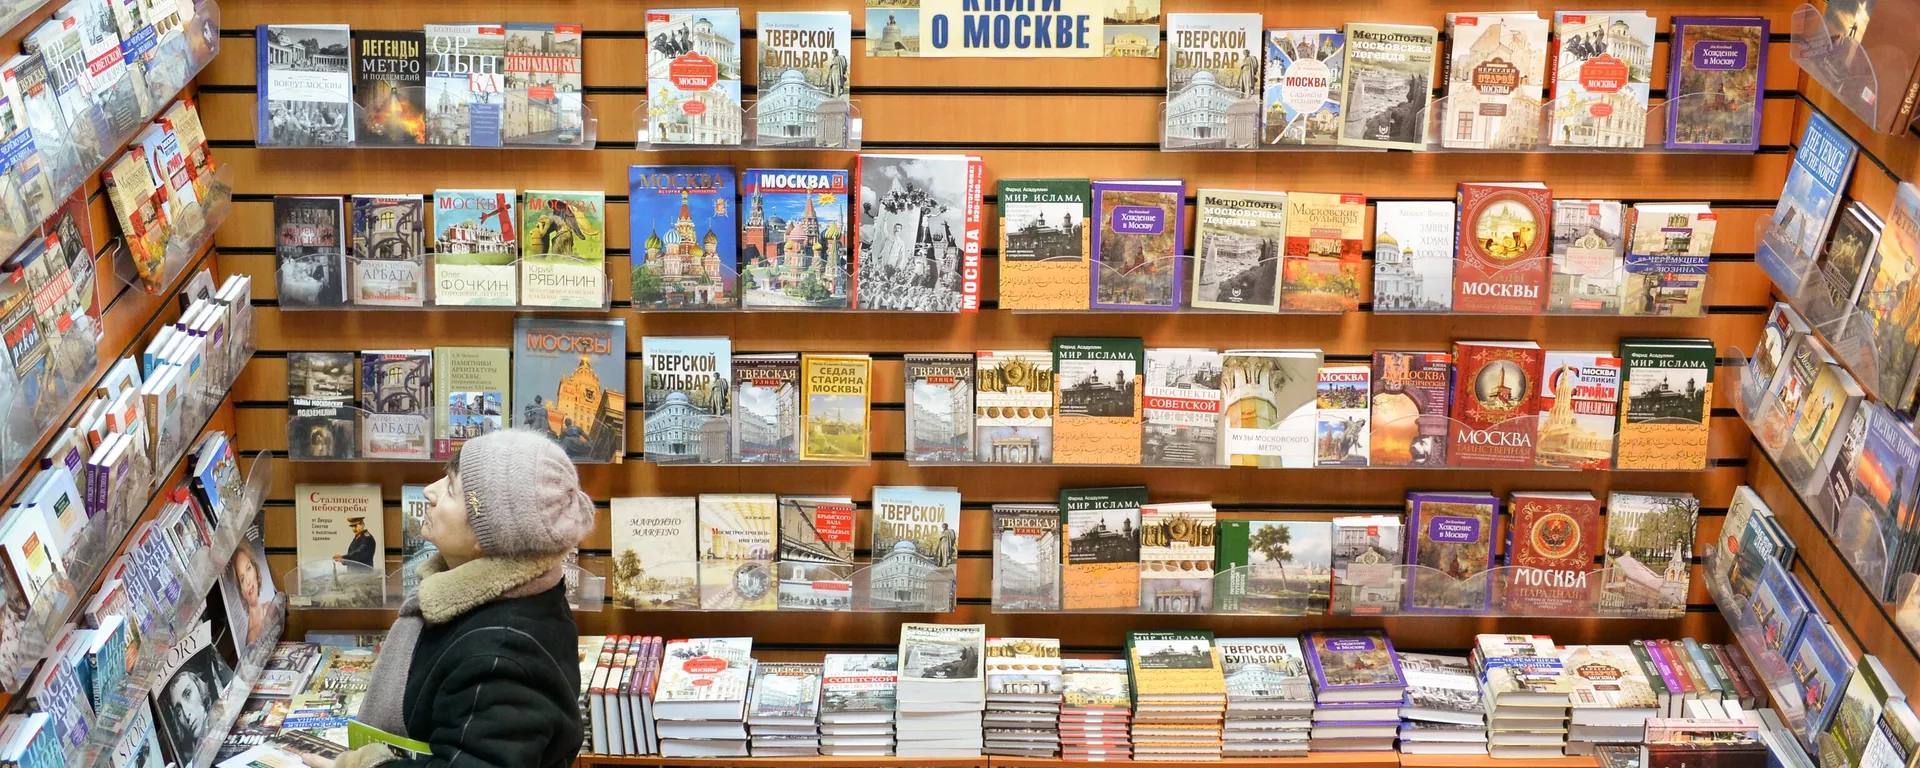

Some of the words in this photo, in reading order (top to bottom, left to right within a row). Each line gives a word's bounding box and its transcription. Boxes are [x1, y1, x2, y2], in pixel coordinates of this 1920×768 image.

[932, 15, 948, 48] О
[963, 15, 1090, 48] МОСКВЕ
[765, 27, 835, 50] ТВЕРСКОЙ
[1176, 28, 1247, 49] ТВЕРСКОЙ
[362, 39, 419, 59] ЛЕГЕНДЫ
[1351, 41, 1432, 54] московская
[1702, 48, 1739, 59] Хождение
[90, 46, 123, 75] СОВЕТСКОЙ
[765, 50, 829, 70] БУЛЬВАР
[1176, 51, 1240, 70] БУЛЬВАР
[1350, 50, 1406, 63] легенда
[1709, 57, 1736, 68] Москву
[362, 58, 420, 74] МЕТРО
[507, 57, 577, 73] ЯКИМАНКА
[362, 73, 369, 81] И
[370, 72, 420, 82] ПОДЗЕМЕЛИЙ
[678, 77, 708, 87] МОСКВЫ
[1286, 76, 1328, 88] МОСКВА
[1477, 74, 1516, 86] СТАРОЙ
[273, 80, 304, 88] ВОКРУГ
[305, 80, 343, 90] МОСКВЫ
[1480, 85, 1510, 94] МОСКВЫ
[1588, 80, 1618, 89] МОСКВЫ
[1905, 82, 1920, 105] Pete
[1901, 102, 1911, 116] St
[1804, 127, 1821, 152] THE
[1817, 139, 1846, 173] VENICE
[1799, 147, 1809, 162] OF
[1806, 153, 1819, 173] THE
[1816, 164, 1838, 189] NORTH
[639, 172, 725, 191] МОСКВА
[761, 173, 831, 190] МОСКВА
[967, 164, 975, 215] ФОТОГРАФИЯХ
[1005, 193, 1031, 203] МИР
[1033, 193, 1082, 203] ИСЛАМА
[528, 197, 597, 213] МОСКВА
[1292, 203, 1360, 217] Московские
[1120, 212, 1156, 223] Хождение
[1203, 207, 1282, 219] московская
[1203, 215, 1257, 228] легенда
[1309, 214, 1360, 226] бульвары
[1891, 204, 1920, 245] PETER
[1128, 222, 1154, 232] Москву
[1420, 222, 1450, 233] ТАЙНЫ
[1420, 236, 1450, 246] ХРАМА
[1416, 249, 1449, 259] ХРИСТА
[362, 268, 415, 281] АРБАТА
[440, 270, 460, 280] Олег
[528, 265, 554, 275] Юрий
[962, 229, 980, 310] МОСКВА
[1655, 265, 1696, 274] ЗЮЗИНА
[440, 279, 509, 292] ФОЧКИН
[528, 274, 596, 288] РЯБИНИН
[1462, 281, 1539, 299] МОСКВЫ
[527, 334, 612, 354] МОСКВЫ
[1059, 351, 1085, 360] МИР
[1088, 351, 1135, 360] ИСЛАМА
[650, 352, 717, 372] ТВЕРСКОЙ
[1381, 354, 1446, 382] МОСКВА
[1630, 359, 1657, 368] МИР
[1660, 359, 1707, 368] ИСЛАМА
[736, 367, 797, 380] ТВЕРСКАЯ
[819, 367, 856, 377] СЕДАЯ
[911, 366, 971, 378] ТВЕРСКАЯ
[1319, 373, 1365, 382] МОСКВА
[1582, 367, 1615, 377] МОСКВА
[650, 373, 711, 391] БУЛЬВАР
[754, 379, 780, 387] УЛИЦА
[811, 376, 864, 385] СТАРИНА
[928, 376, 954, 384] УЛИЦА
[1581, 376, 1616, 385] ВЕЛИКИЕ
[812, 384, 862, 393] МОСКВЫ
[1151, 387, 1217, 399] ПРОСПЕКТЫ
[293, 399, 311, 408] ТАЙНЫ
[311, 399, 344, 409] МОСКОВСКИХ
[1149, 399, 1217, 411] СОВЕТСКОЙ
[1574, 401, 1614, 415] СОЦИАЛИЗМА
[297, 408, 338, 418] ПОДЗЕМЕЛИЙ
[1150, 411, 1217, 424] МОСКВЫ
[371, 423, 423, 435] АРБАТА
[1232, 434, 1254, 443] МУЗЫ
[1255, 434, 1309, 444] МОСКОВСКОГО
[1457, 429, 1531, 448] МОСКВА
[1873, 412, 1899, 448] БЕЛЫЕ
[1897, 438, 1918, 469] НОЧИ
[1258, 444, 1283, 452] МЕТРО
[1456, 444, 1530, 457] ТАИНСТВЕННАЯ
[309, 491, 369, 504] Сталинские
[311, 505, 367, 513] небоскребы
[1068, 501, 1090, 510] МИР
[1098, 500, 1140, 509] ИСЛАМА
[881, 503, 946, 523] ТВЕРСКОЙ
[629, 517, 682, 526] МАРФИНО
[998, 517, 1057, 529] ТВЕРСКАЯ
[1438, 522, 1472, 533] Хождение
[631, 528, 681, 537] MARFINO
[880, 521, 939, 540] БУЛЬВАР
[1445, 531, 1469, 541] Москву
[1514, 569, 1587, 589] МОСКВА
[1519, 588, 1579, 599] ПАРАДНАЯ
[1222, 644, 1287, 655] ТВЕРСКОЙ
[1225, 655, 1283, 664] БУЛЬВАР
[762, 666, 820, 674] ТВЕРСКАЯ
[324, 678, 368, 691] Москв
[118, 713, 148, 759] STORY
